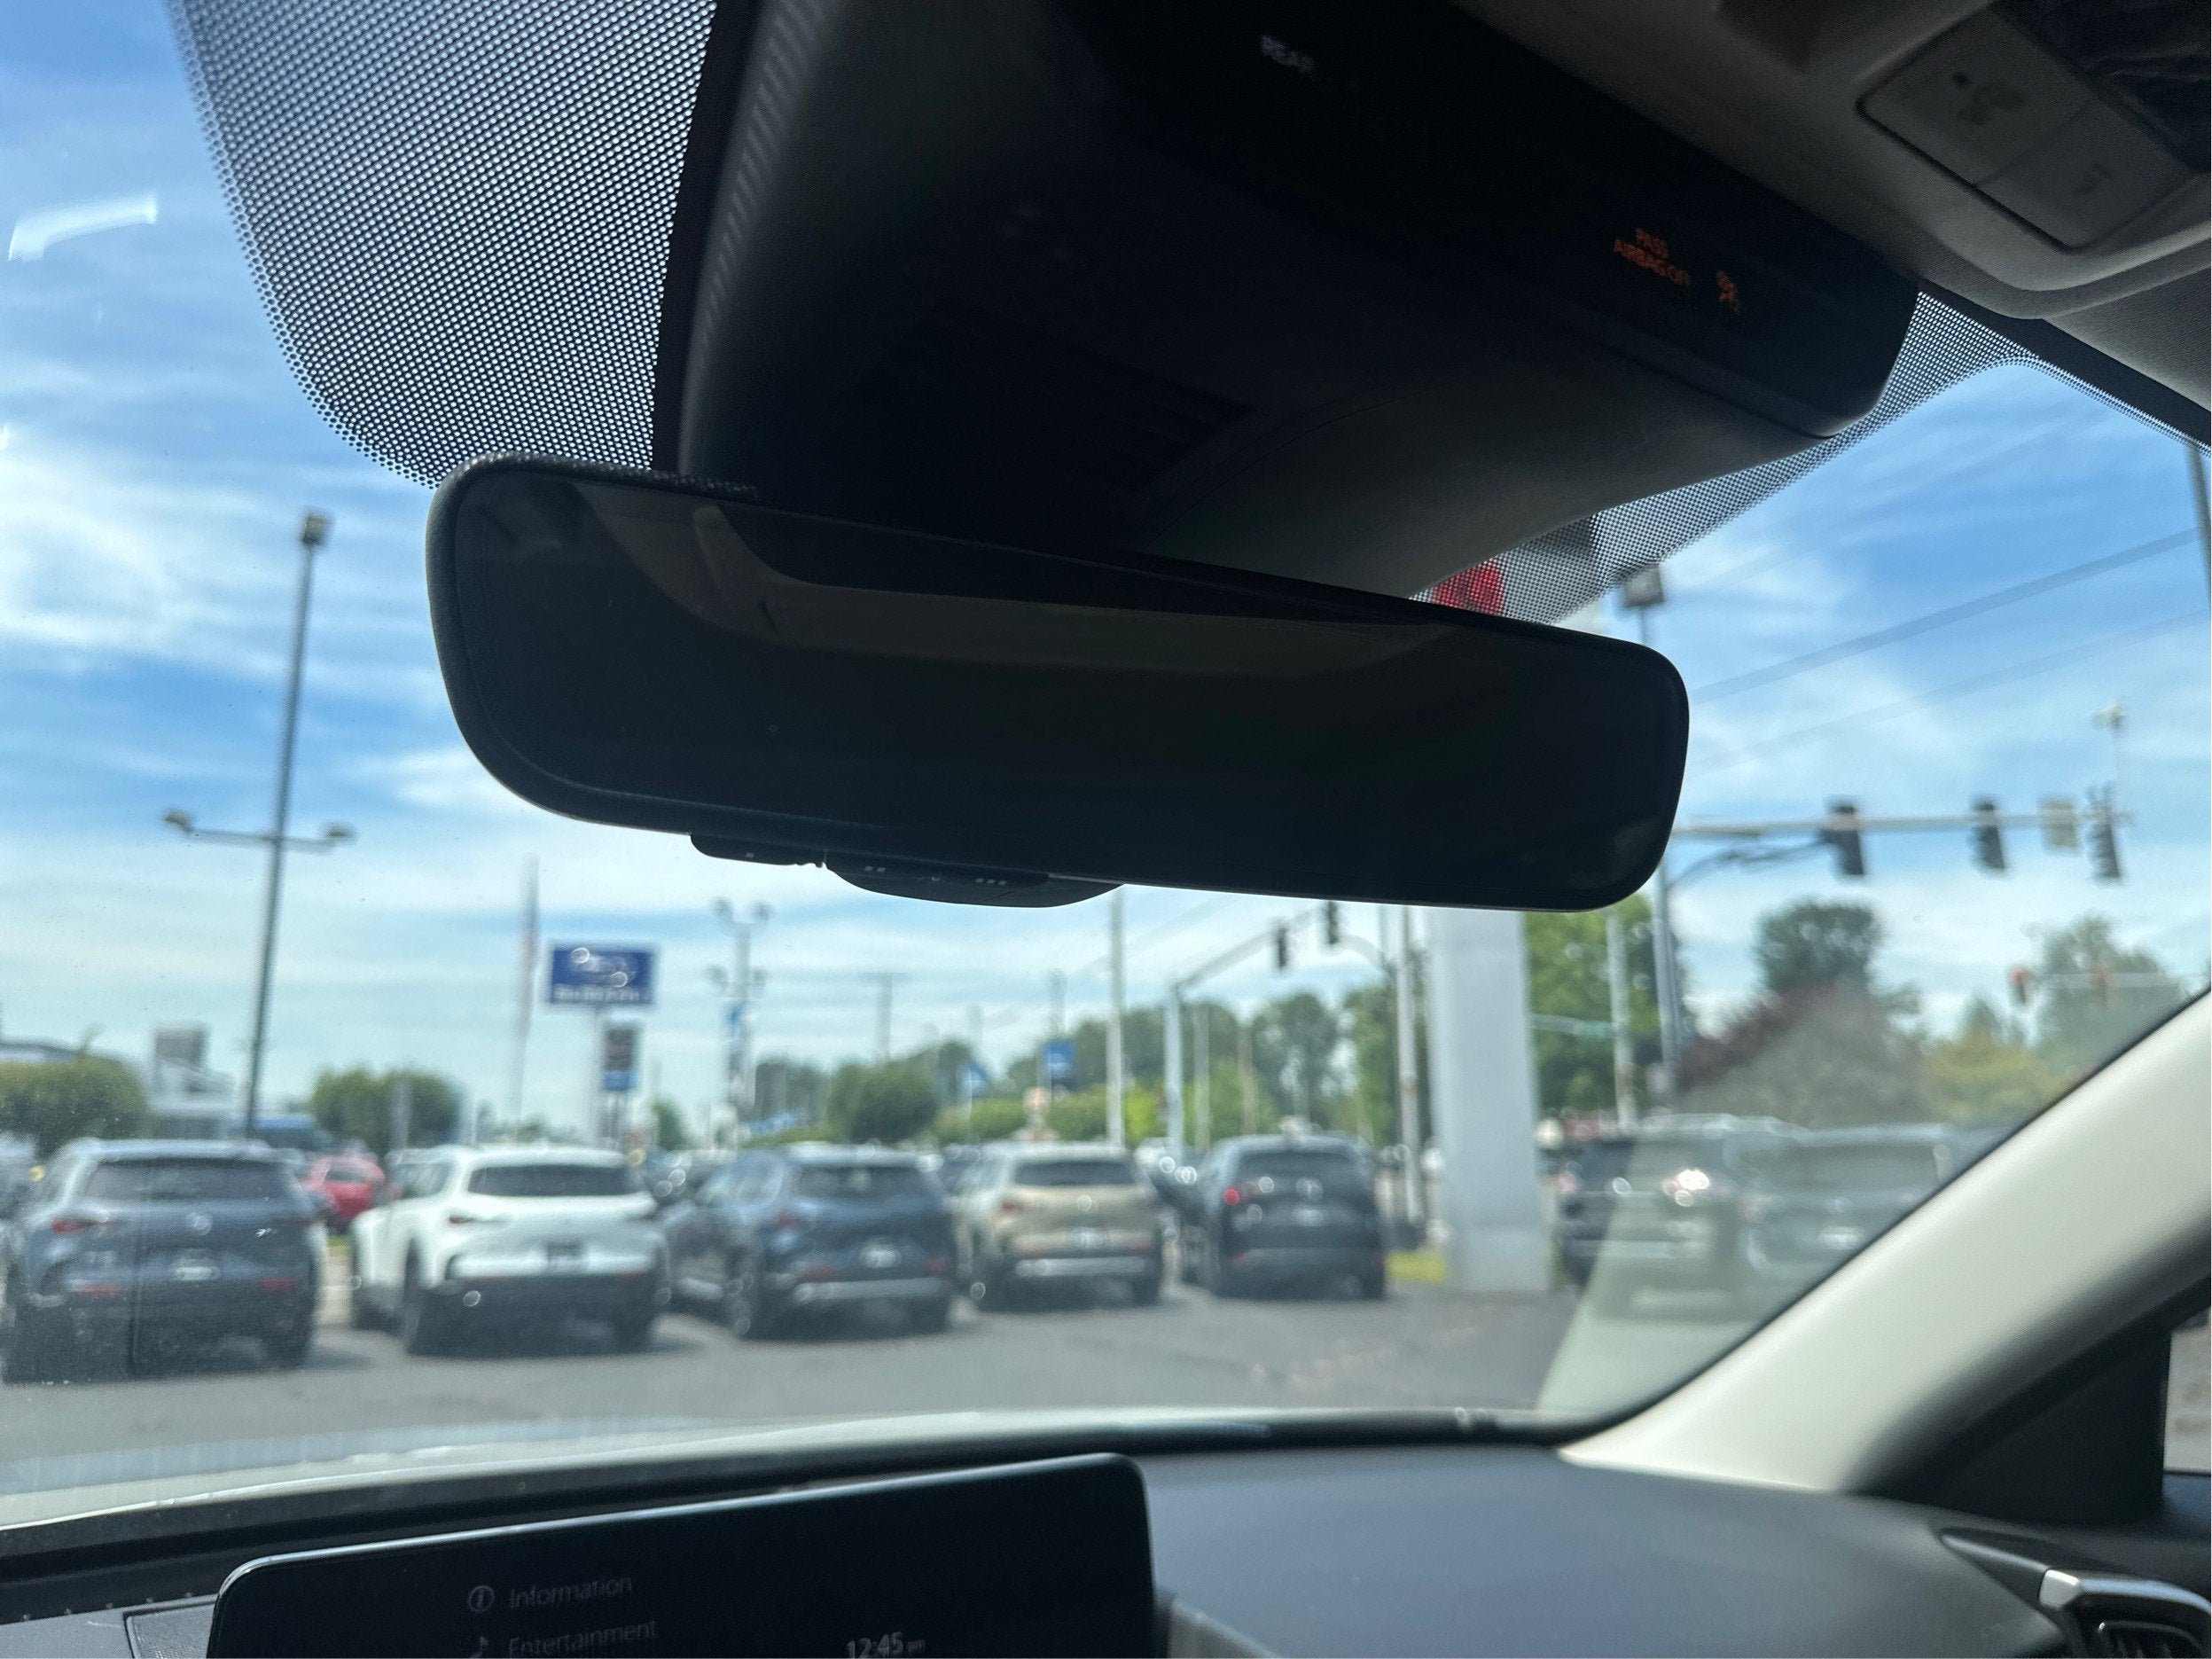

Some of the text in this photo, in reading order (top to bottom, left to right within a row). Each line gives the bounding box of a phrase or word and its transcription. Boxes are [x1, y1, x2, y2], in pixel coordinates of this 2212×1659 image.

[509, 1577, 633, 1608] Information
[508, 1620, 657, 1658] Entertainment
[847, 1632, 903, 1658] 12:45
